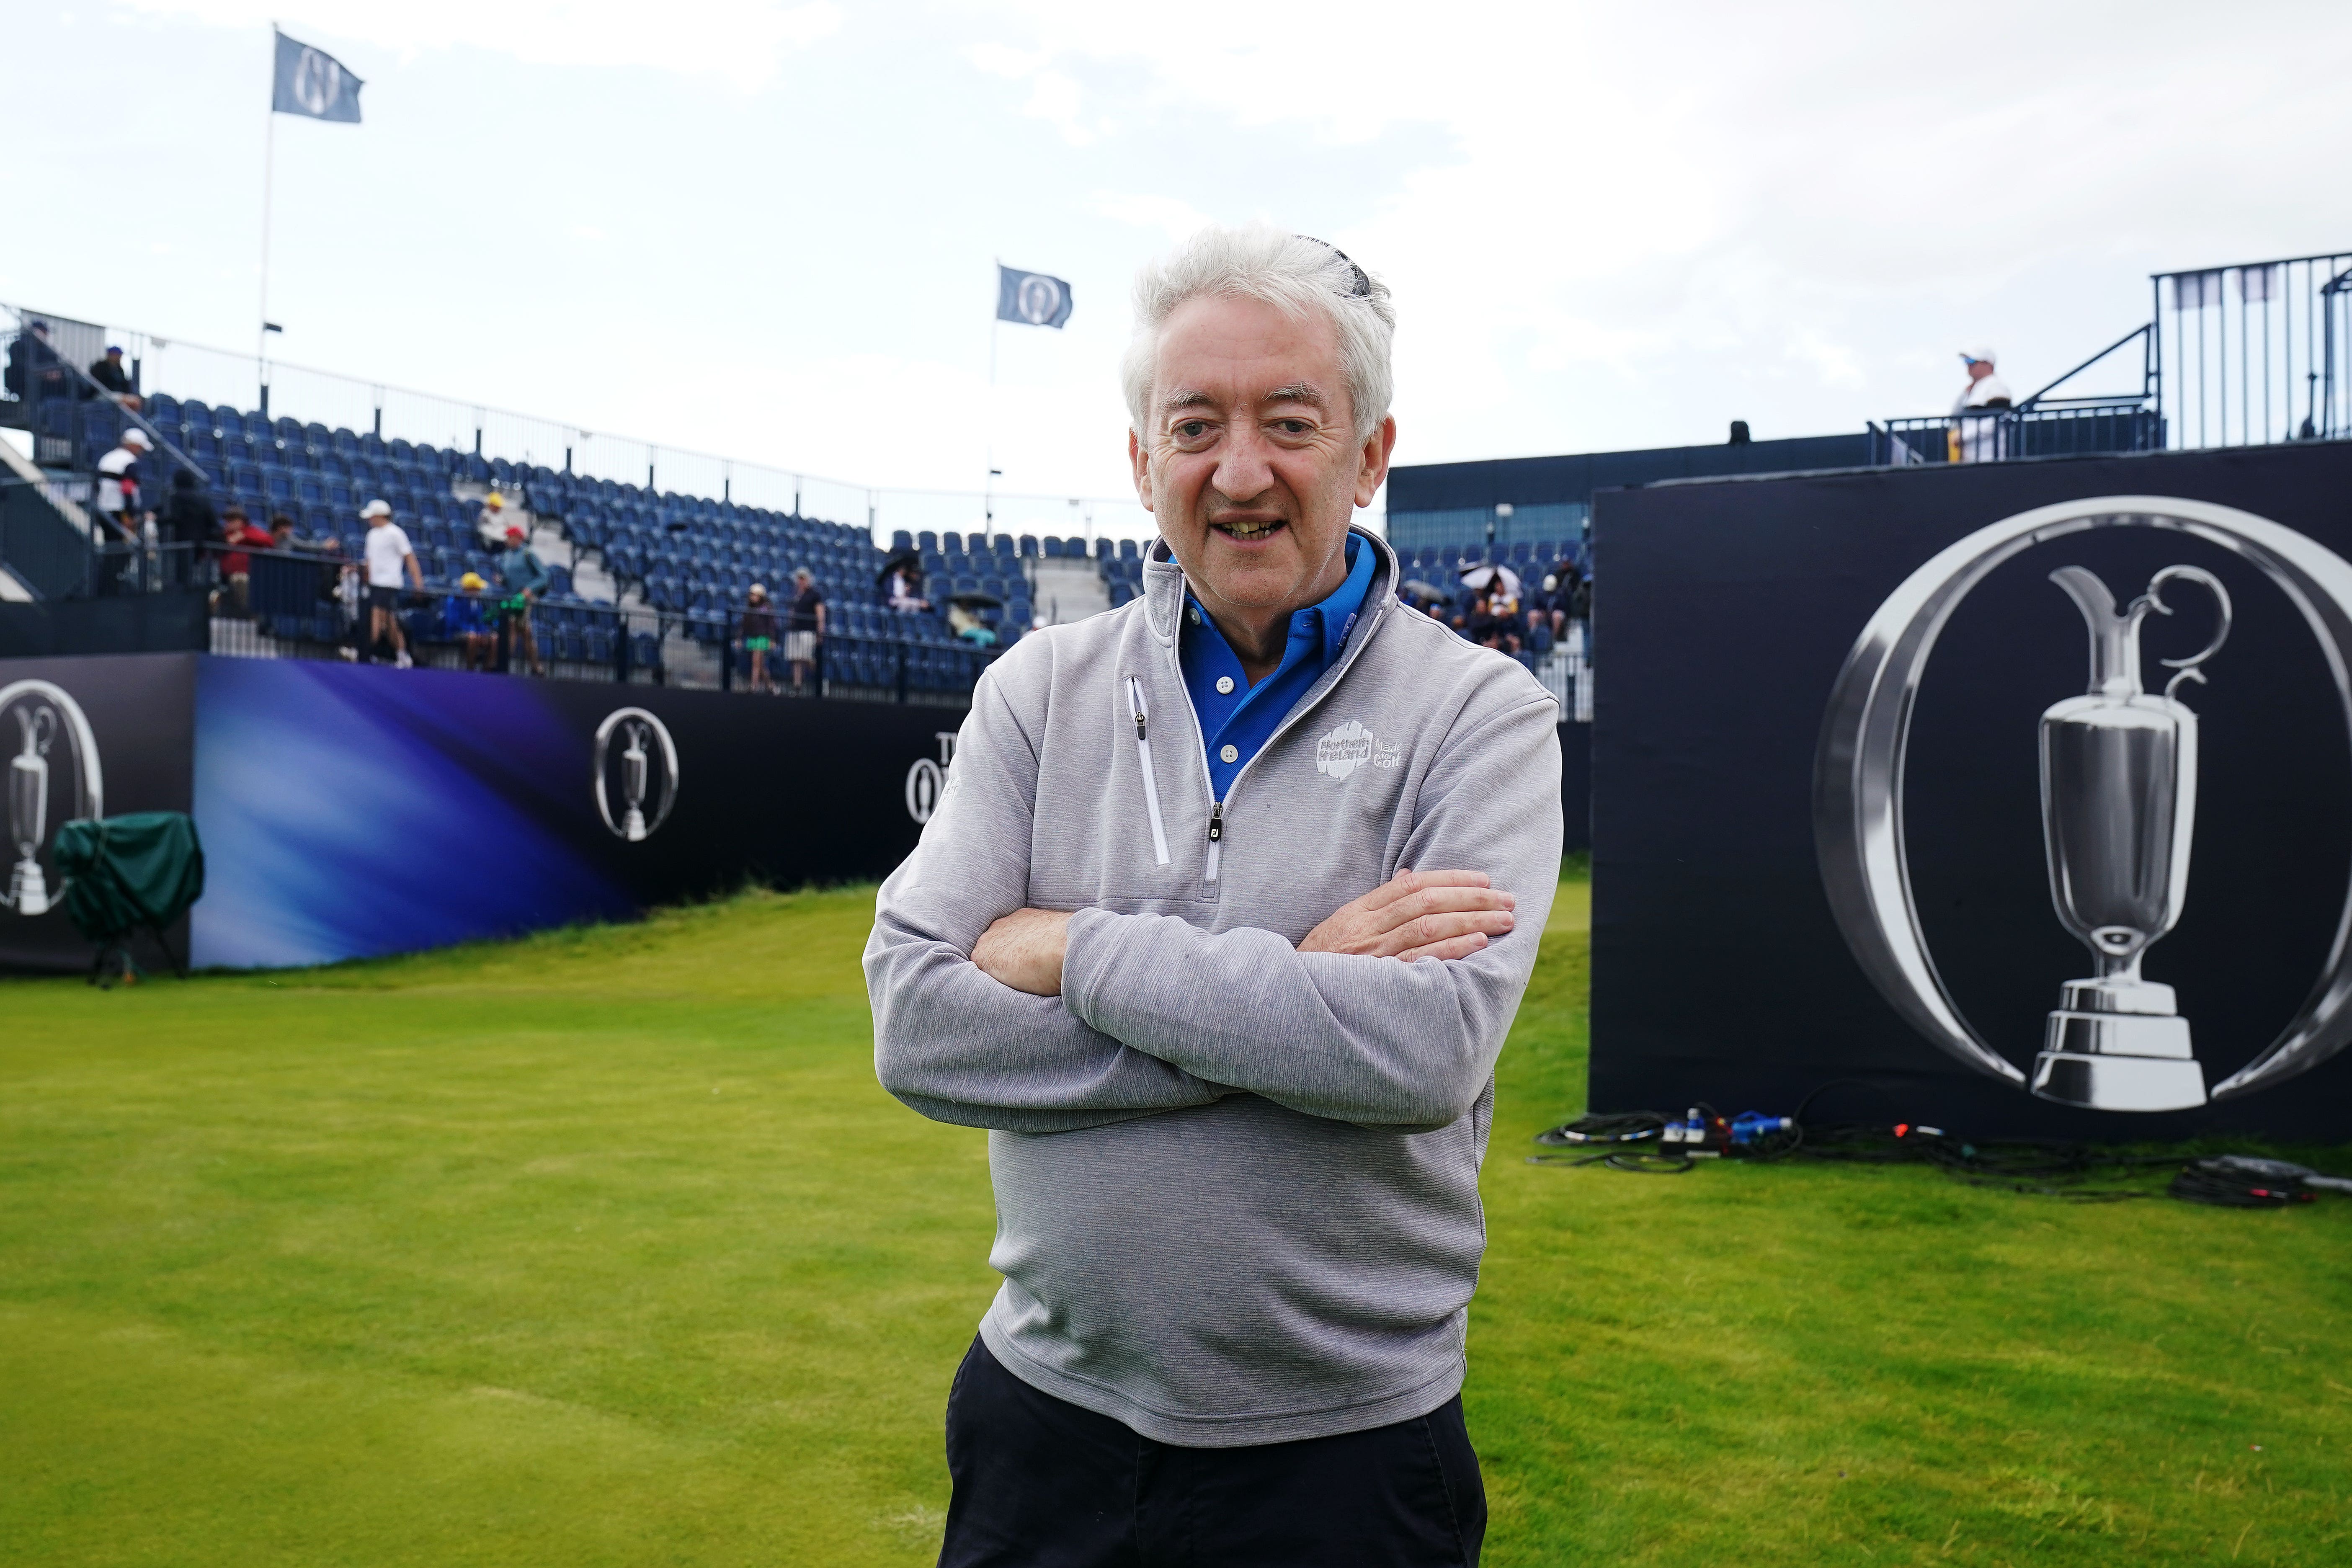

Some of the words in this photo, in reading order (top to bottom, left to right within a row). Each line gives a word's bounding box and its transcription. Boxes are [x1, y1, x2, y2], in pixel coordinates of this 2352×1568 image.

[1320, 737, 1369, 750] Northern
[1375, 738, 1402, 752] Made
[1318, 745, 1368, 761] Ireland
[1374, 752, 1401, 768] Golf
